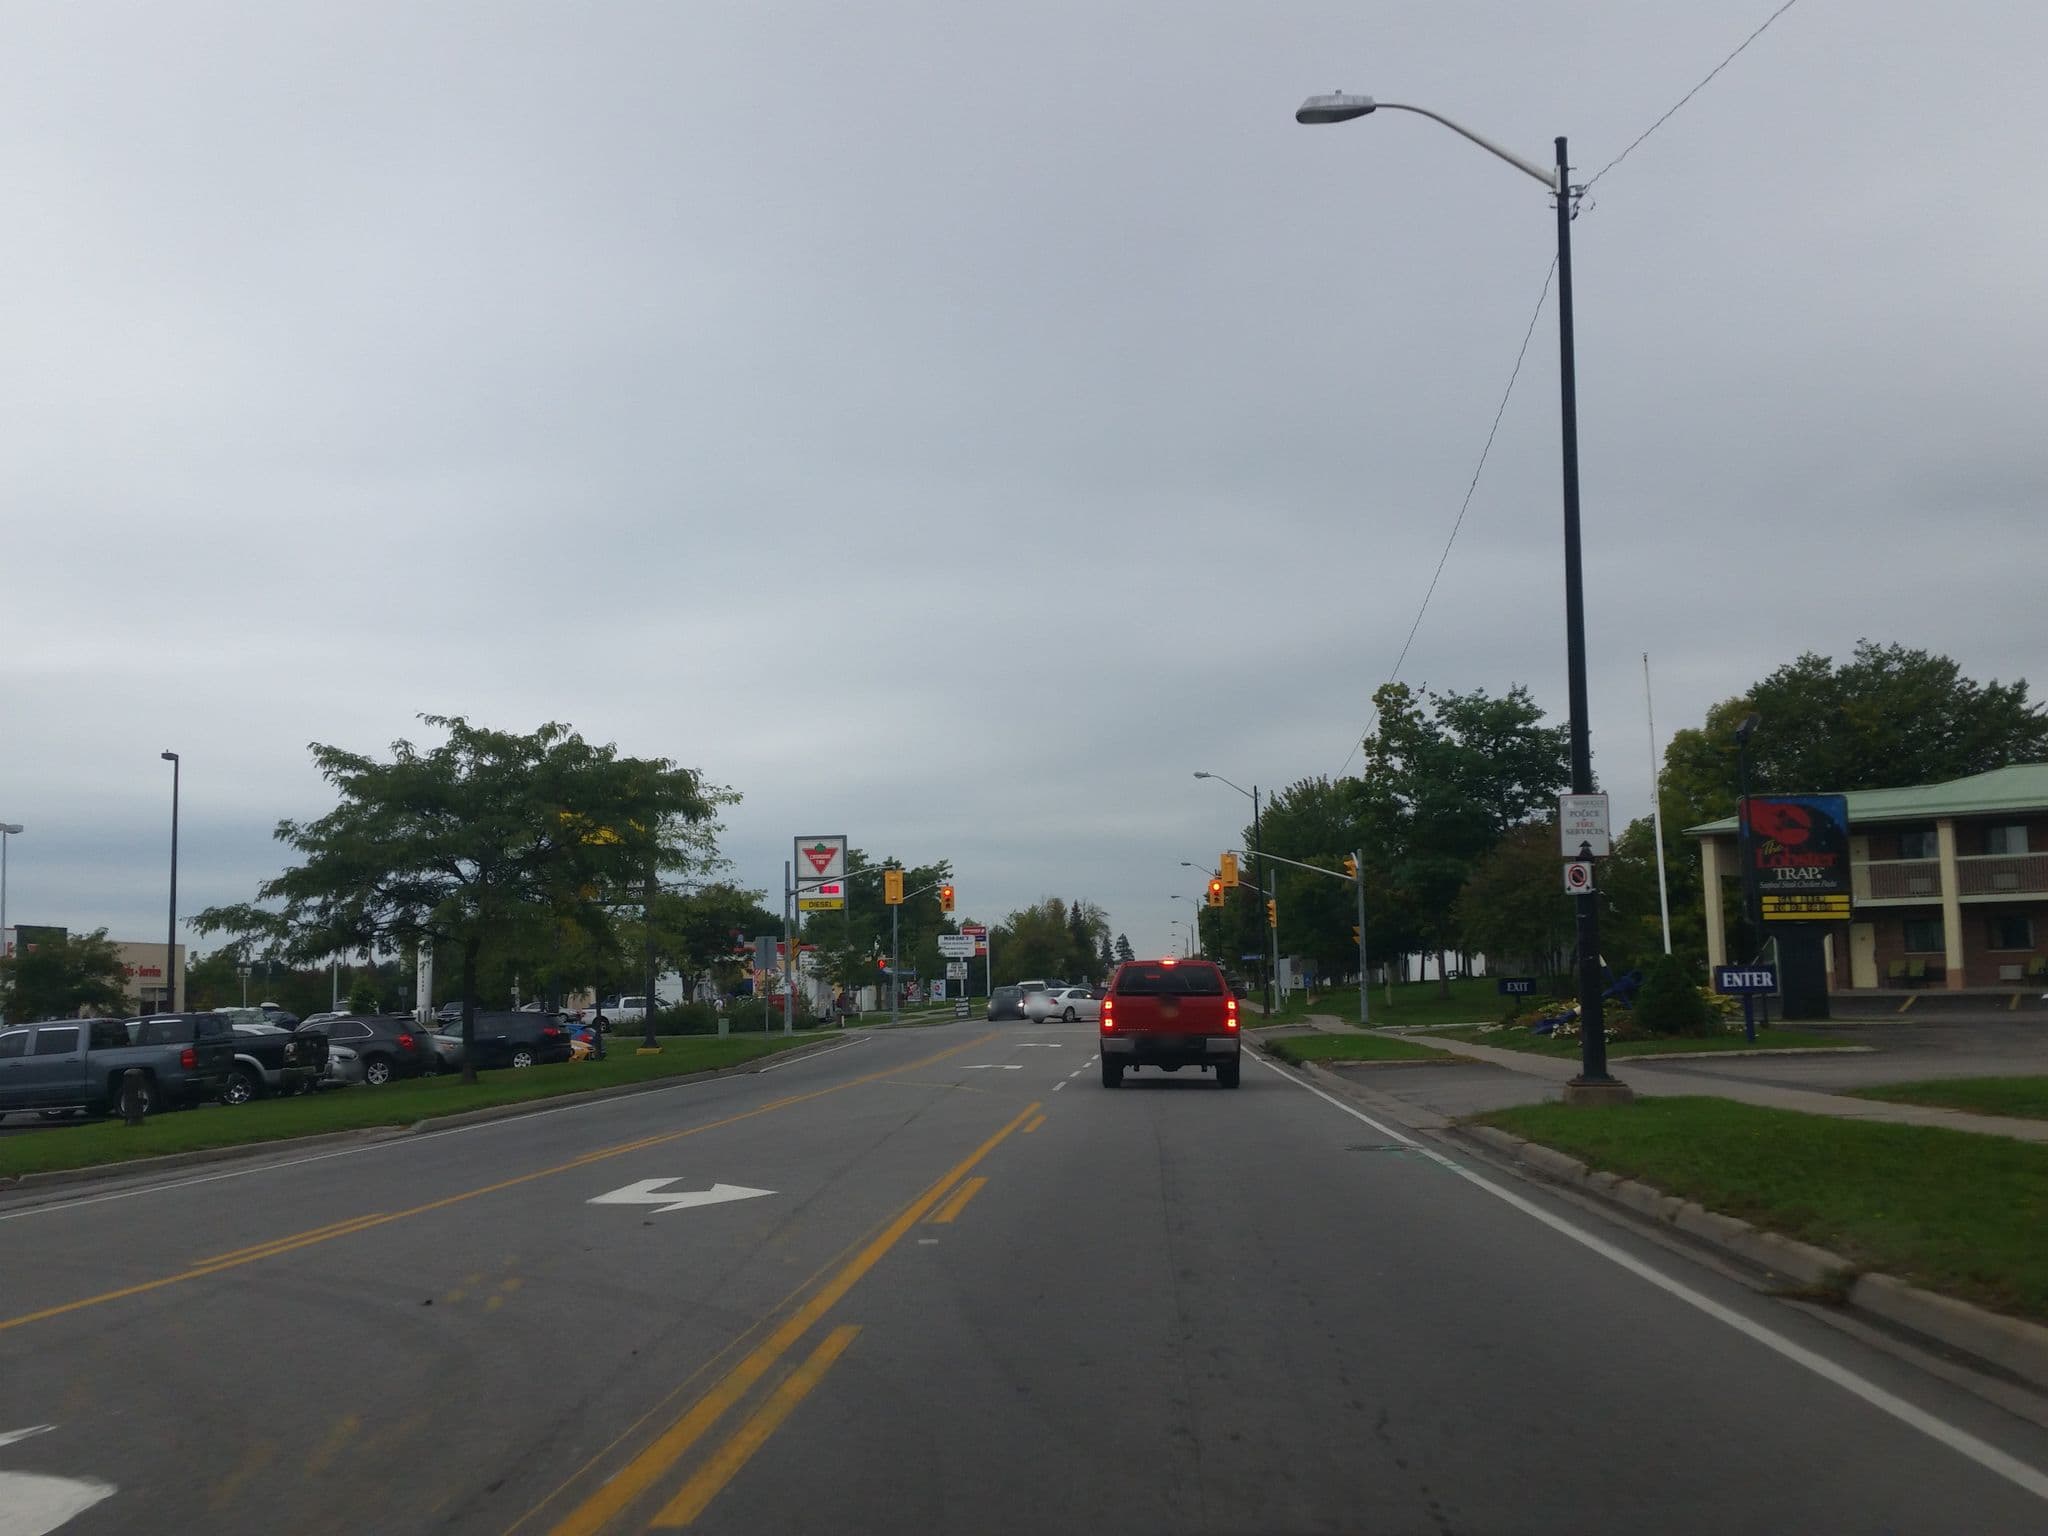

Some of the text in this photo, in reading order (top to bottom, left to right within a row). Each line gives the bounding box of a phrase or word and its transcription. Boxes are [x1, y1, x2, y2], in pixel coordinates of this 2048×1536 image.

[1761, 839, 1784, 855] The
[139, 965, 161, 977] Service
[1722, 971, 1774, 988] ENTER
[1506, 982, 1529, 992] EXIT
